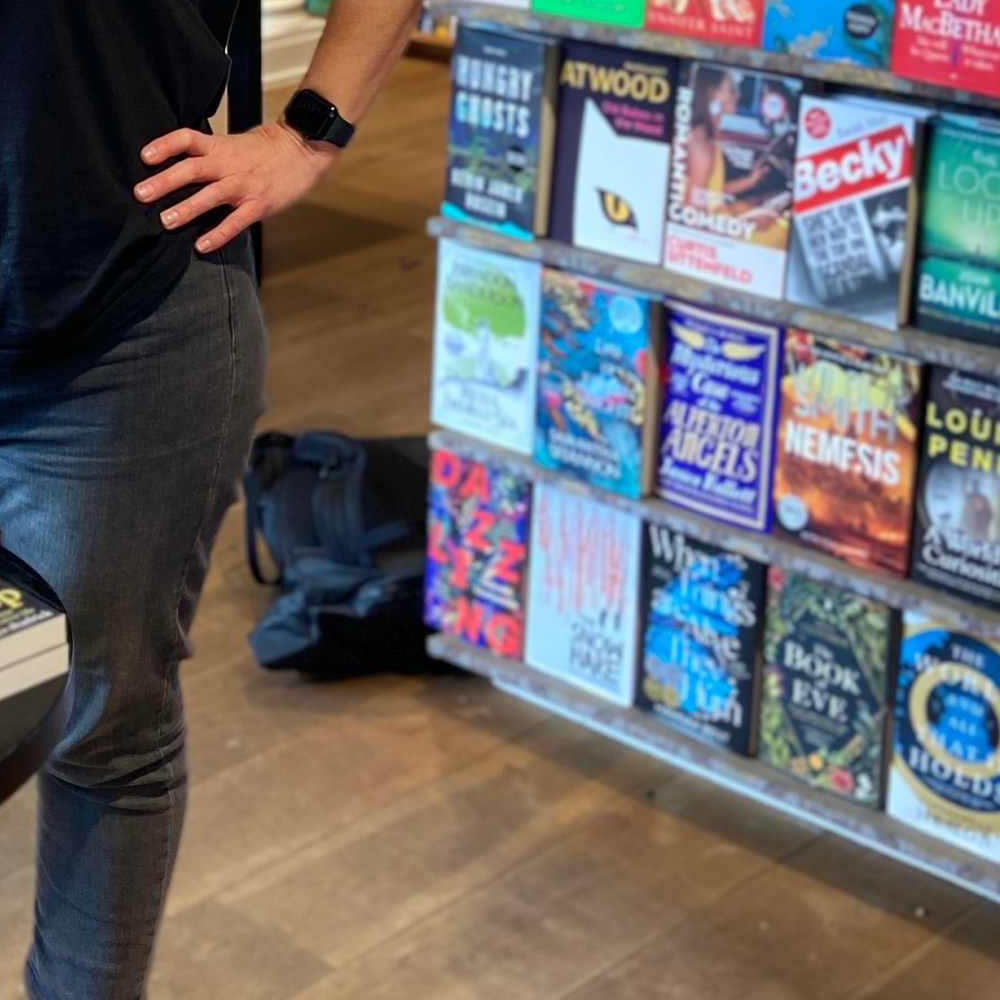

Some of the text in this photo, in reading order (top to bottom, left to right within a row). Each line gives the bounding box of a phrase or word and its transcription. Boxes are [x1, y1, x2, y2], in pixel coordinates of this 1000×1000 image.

[455, 53, 534, 104] HUNGRY
[559, 58, 671, 106] ATWOOD
[454, 91, 532, 140] GHOSTS
[795, 135, 906, 198] Becky
[660, 426, 760, 484] ANGELS
[783, 420, 902, 487] NEMESIS
[783, 639, 862, 697] BOOK
[792, 679, 849, 724] EVE
